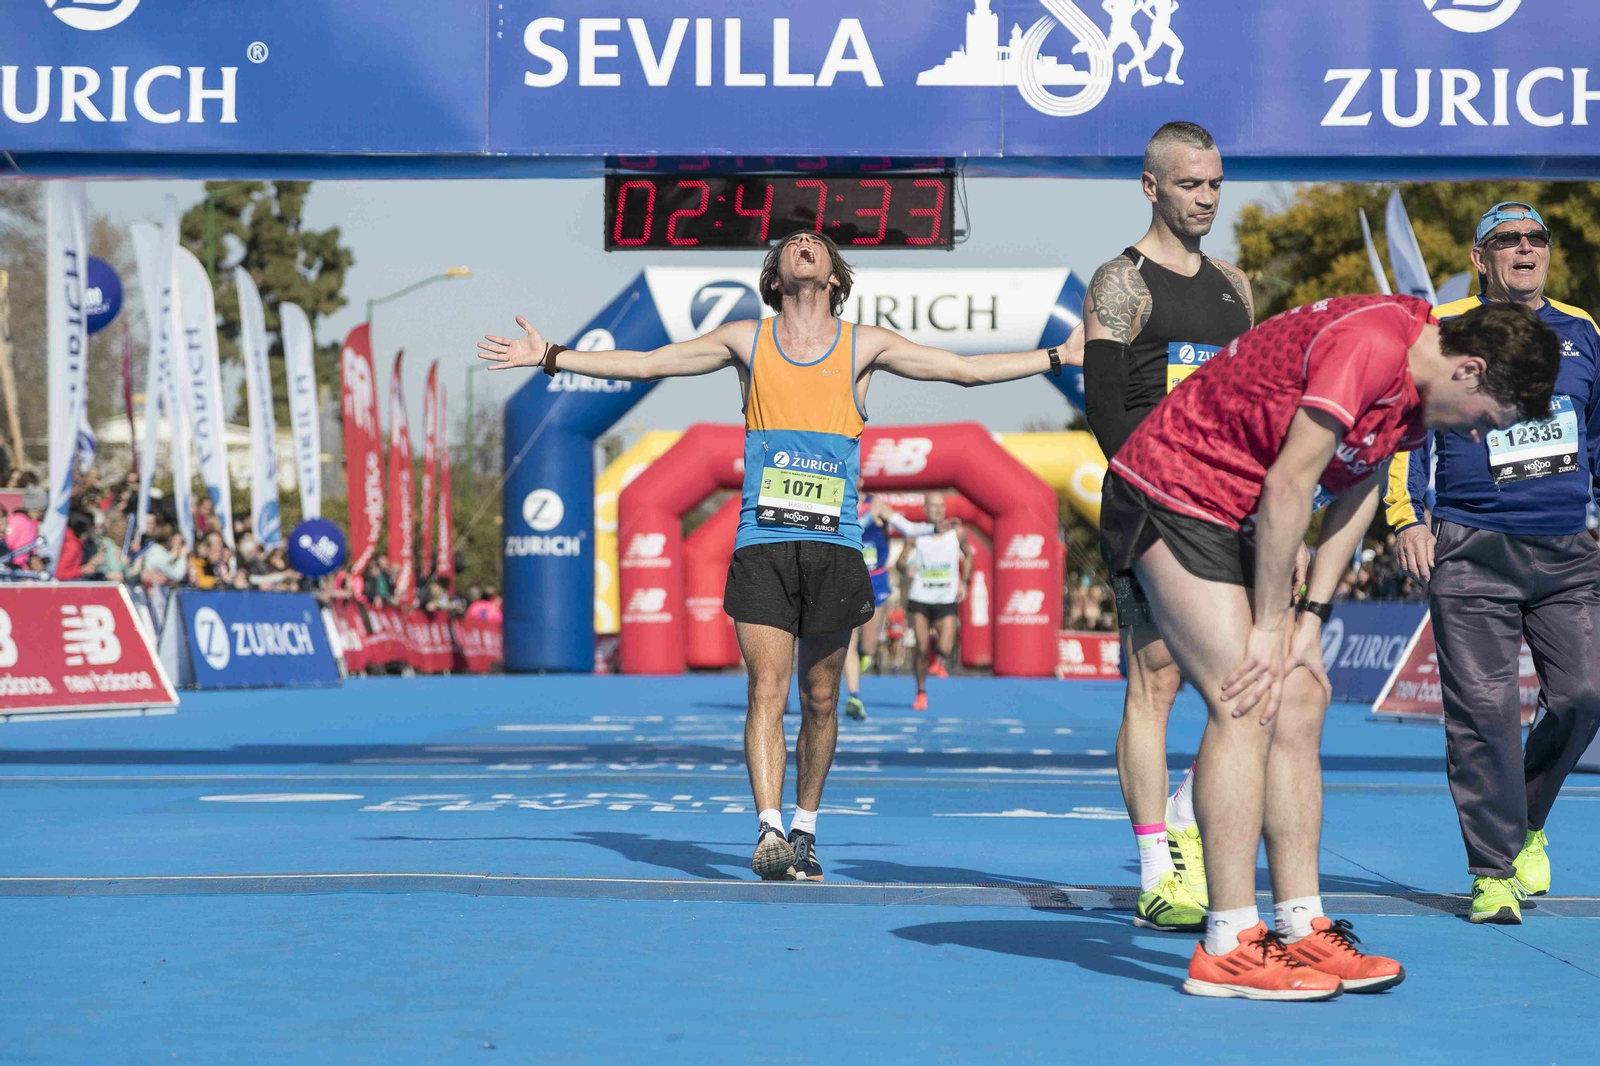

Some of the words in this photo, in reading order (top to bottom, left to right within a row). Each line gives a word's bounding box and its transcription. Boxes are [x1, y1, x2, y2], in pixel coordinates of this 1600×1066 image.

[522, 16, 884, 88] SEVILLA
[0, 65, 239, 124] URICH
[613, 178, 946, 246] 02:47:33
[857, 293, 1000, 331] RICH
[1505, 422, 1563, 447] 12335
[792, 457, 838, 473] ZURICH
[783, 479, 823, 499] 1071
[814, 524, 836, 532] ZURICH
[505, 535, 582, 557] ZURICH
[230, 622, 315, 656] ZURICH
[1338, 634, 1408, 670] ZURIC
